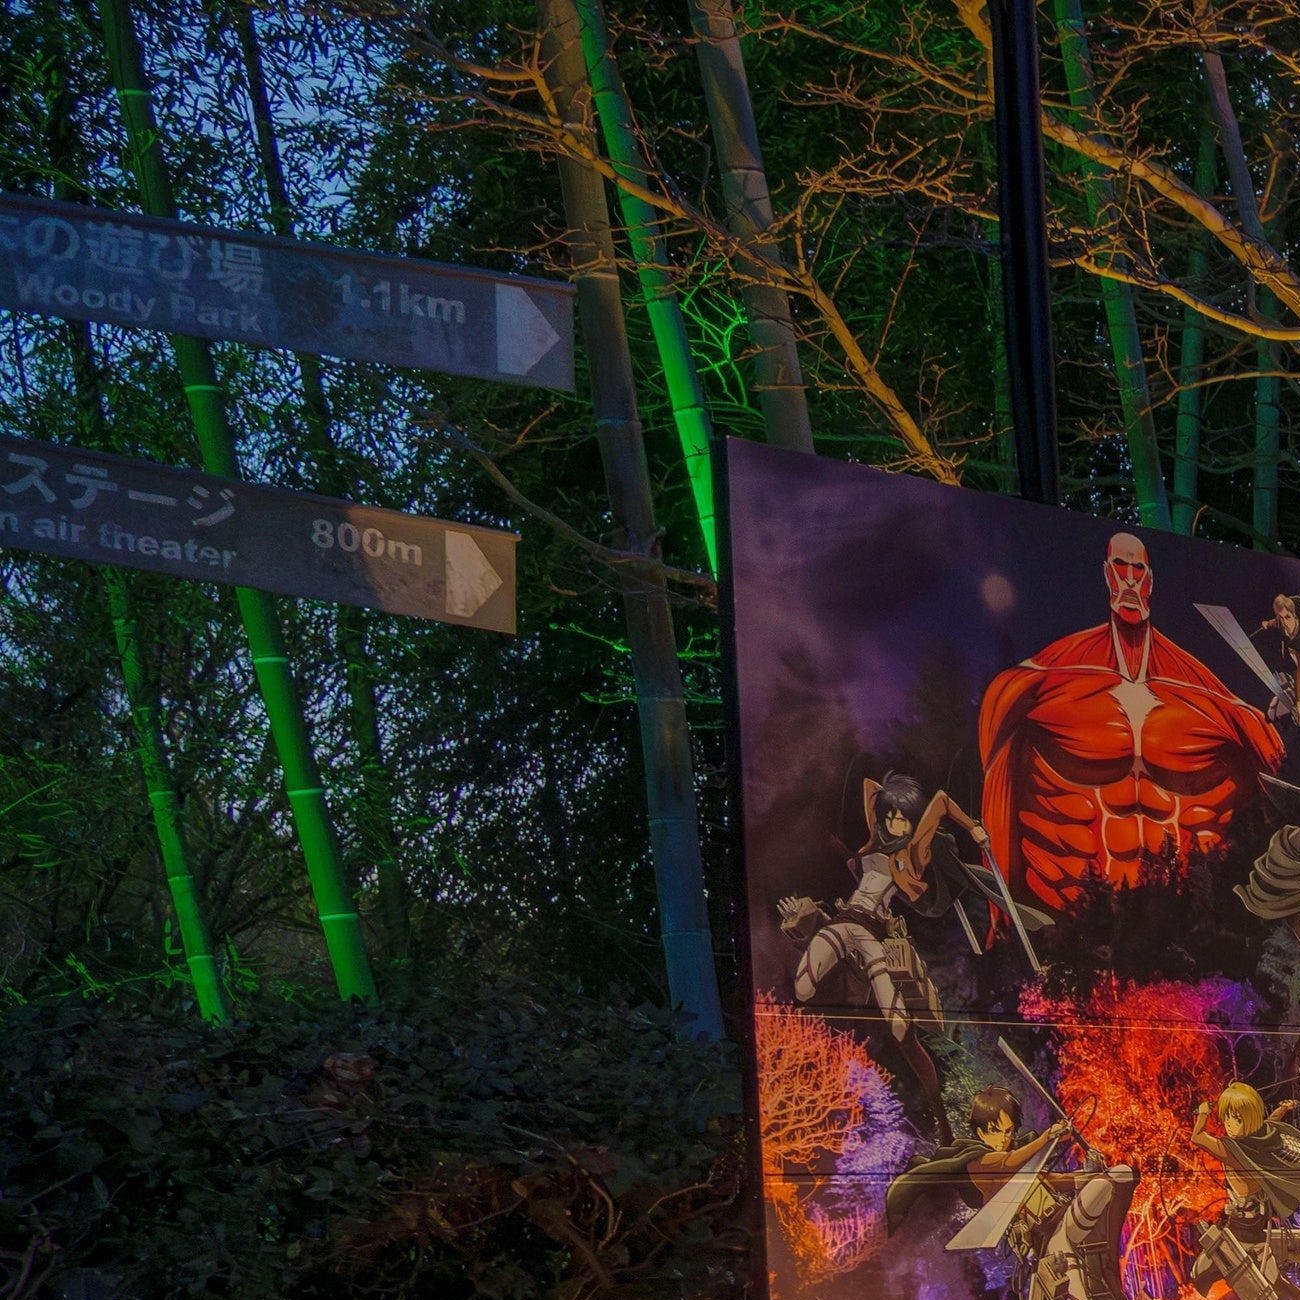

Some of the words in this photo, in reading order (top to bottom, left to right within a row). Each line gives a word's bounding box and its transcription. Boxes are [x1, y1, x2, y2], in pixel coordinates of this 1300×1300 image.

[15, 262, 156, 322] Woody
[172, 284, 264, 334] Park
[32, 514, 87, 543] air
[99, 523, 238, 570] theater
[311, 518, 423, 567] 800m
